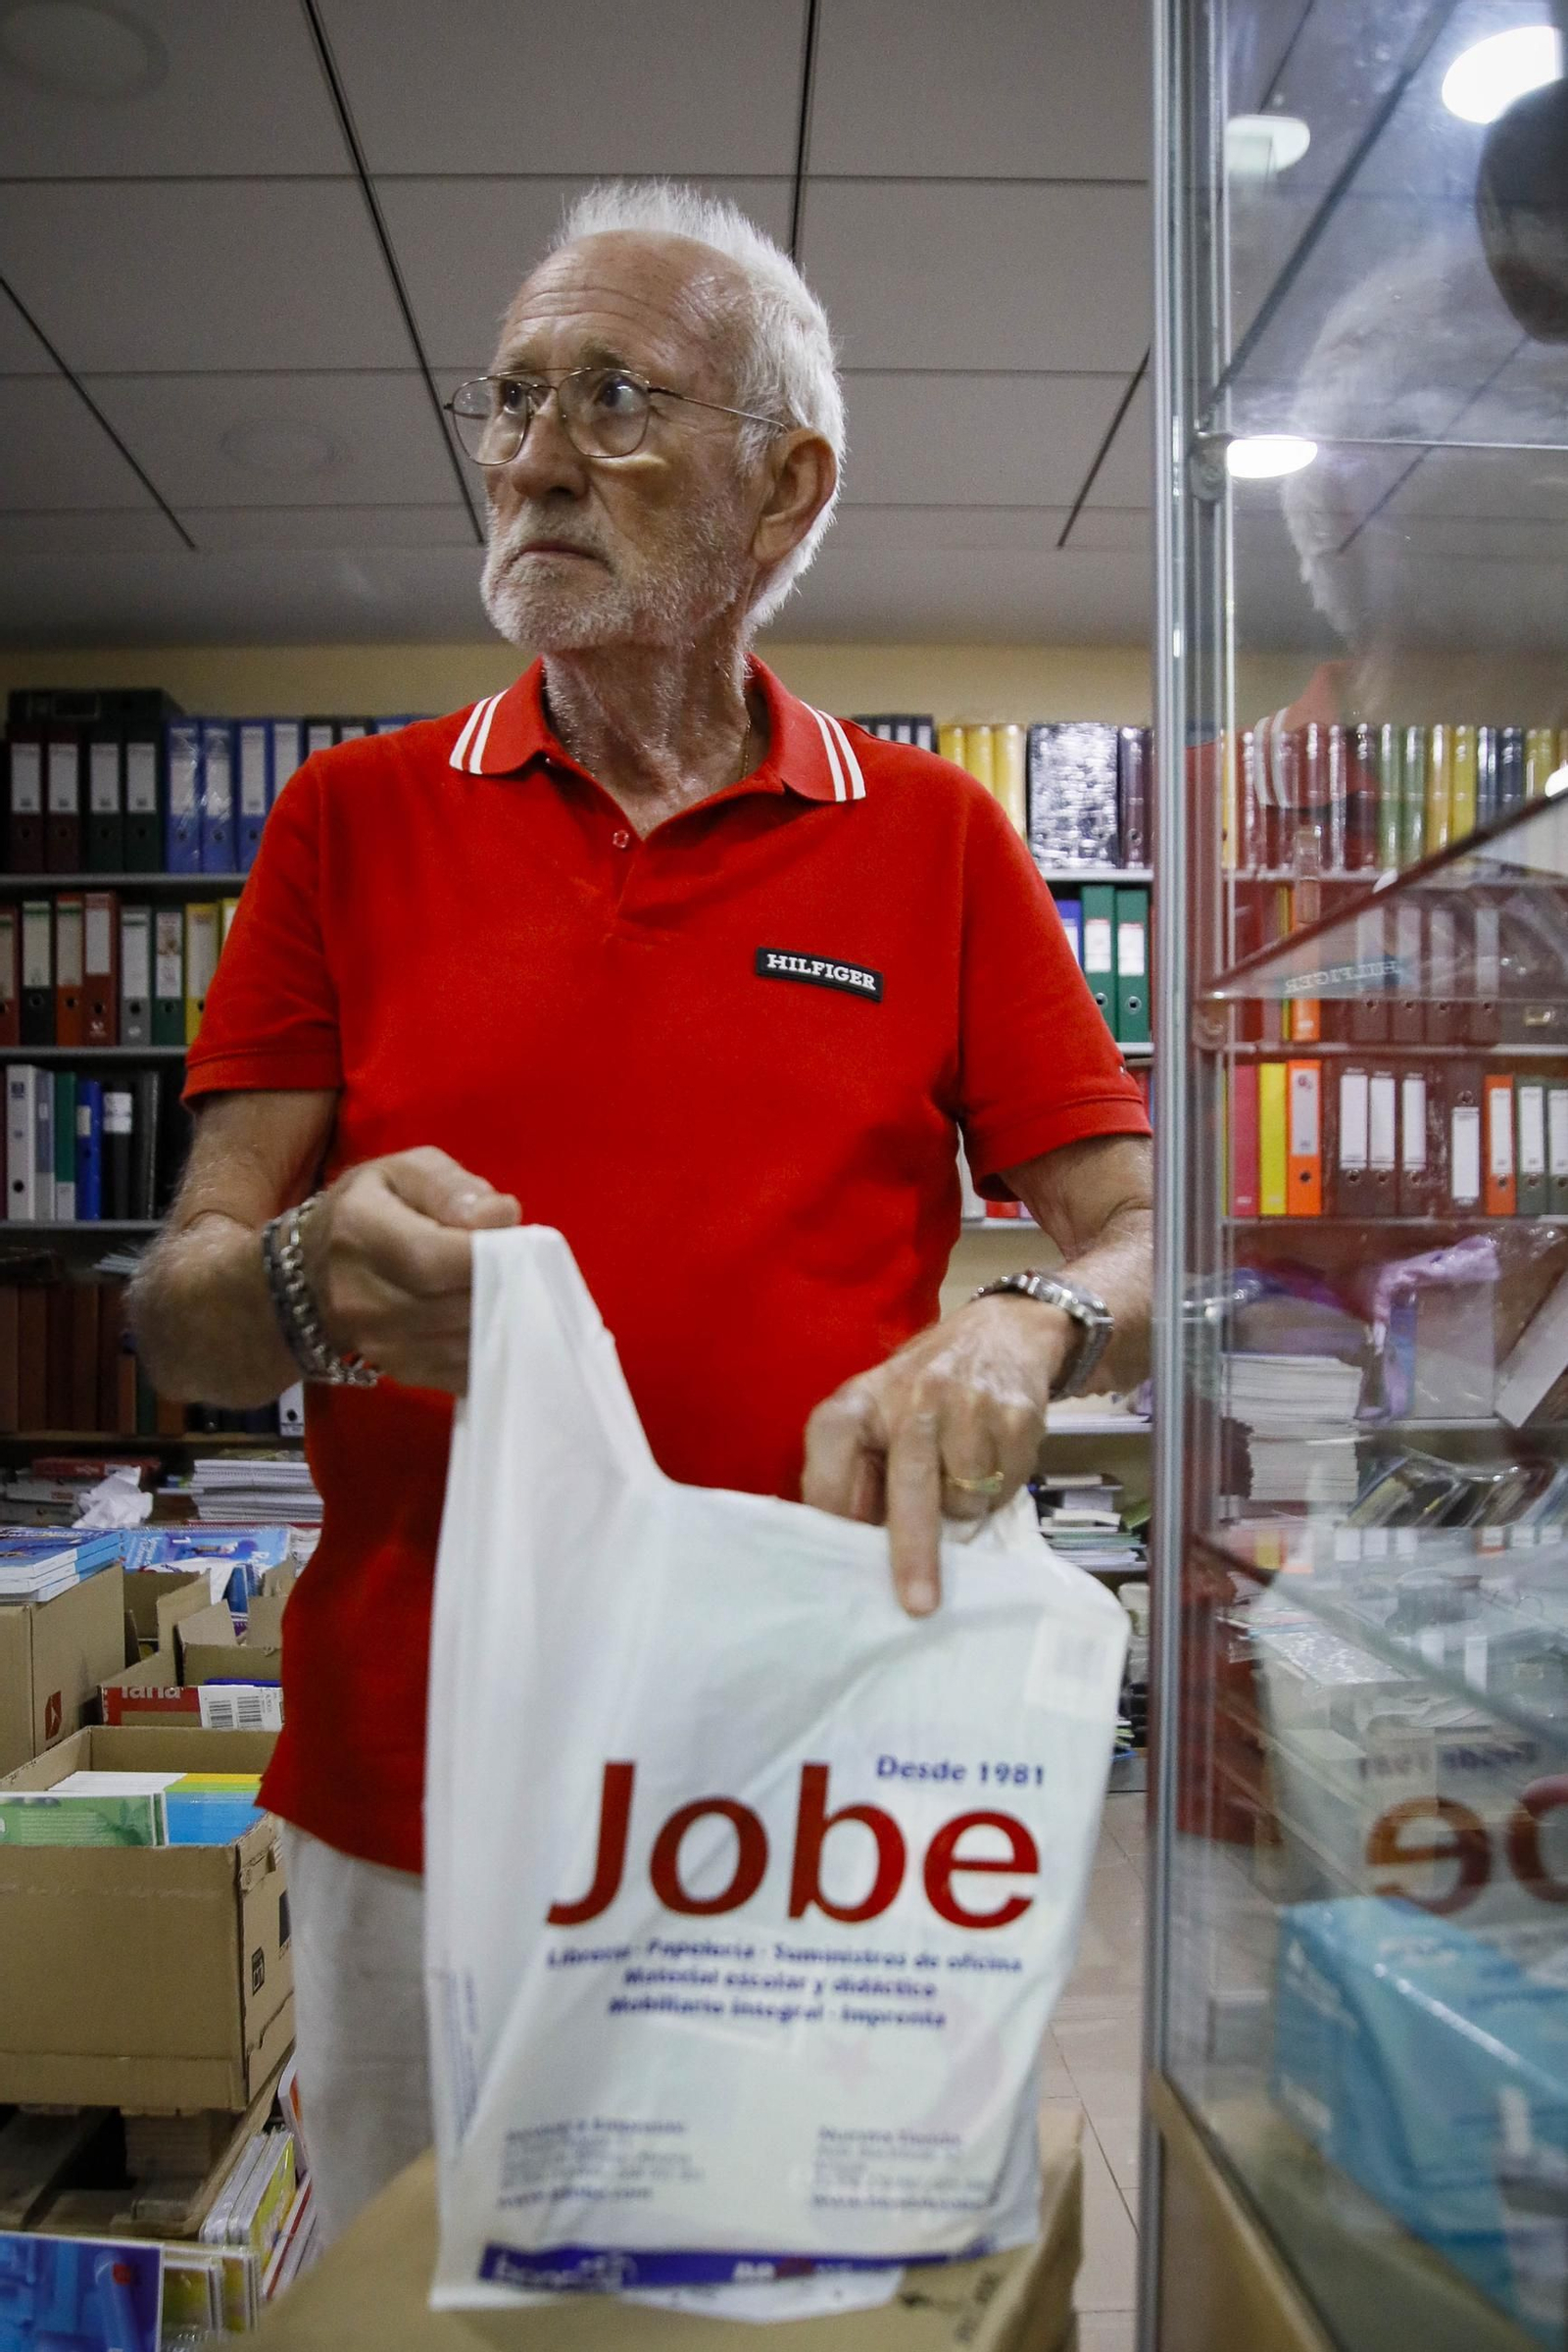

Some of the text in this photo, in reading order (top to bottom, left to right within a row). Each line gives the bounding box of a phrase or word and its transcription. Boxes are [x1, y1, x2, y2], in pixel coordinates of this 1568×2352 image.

[767, 954, 876, 991] HILFIGER
[877, 1754, 1044, 1787] Desde 1981
[546, 1761, 1040, 1930] Jobe
[624, 1968, 717, 1986] Material
